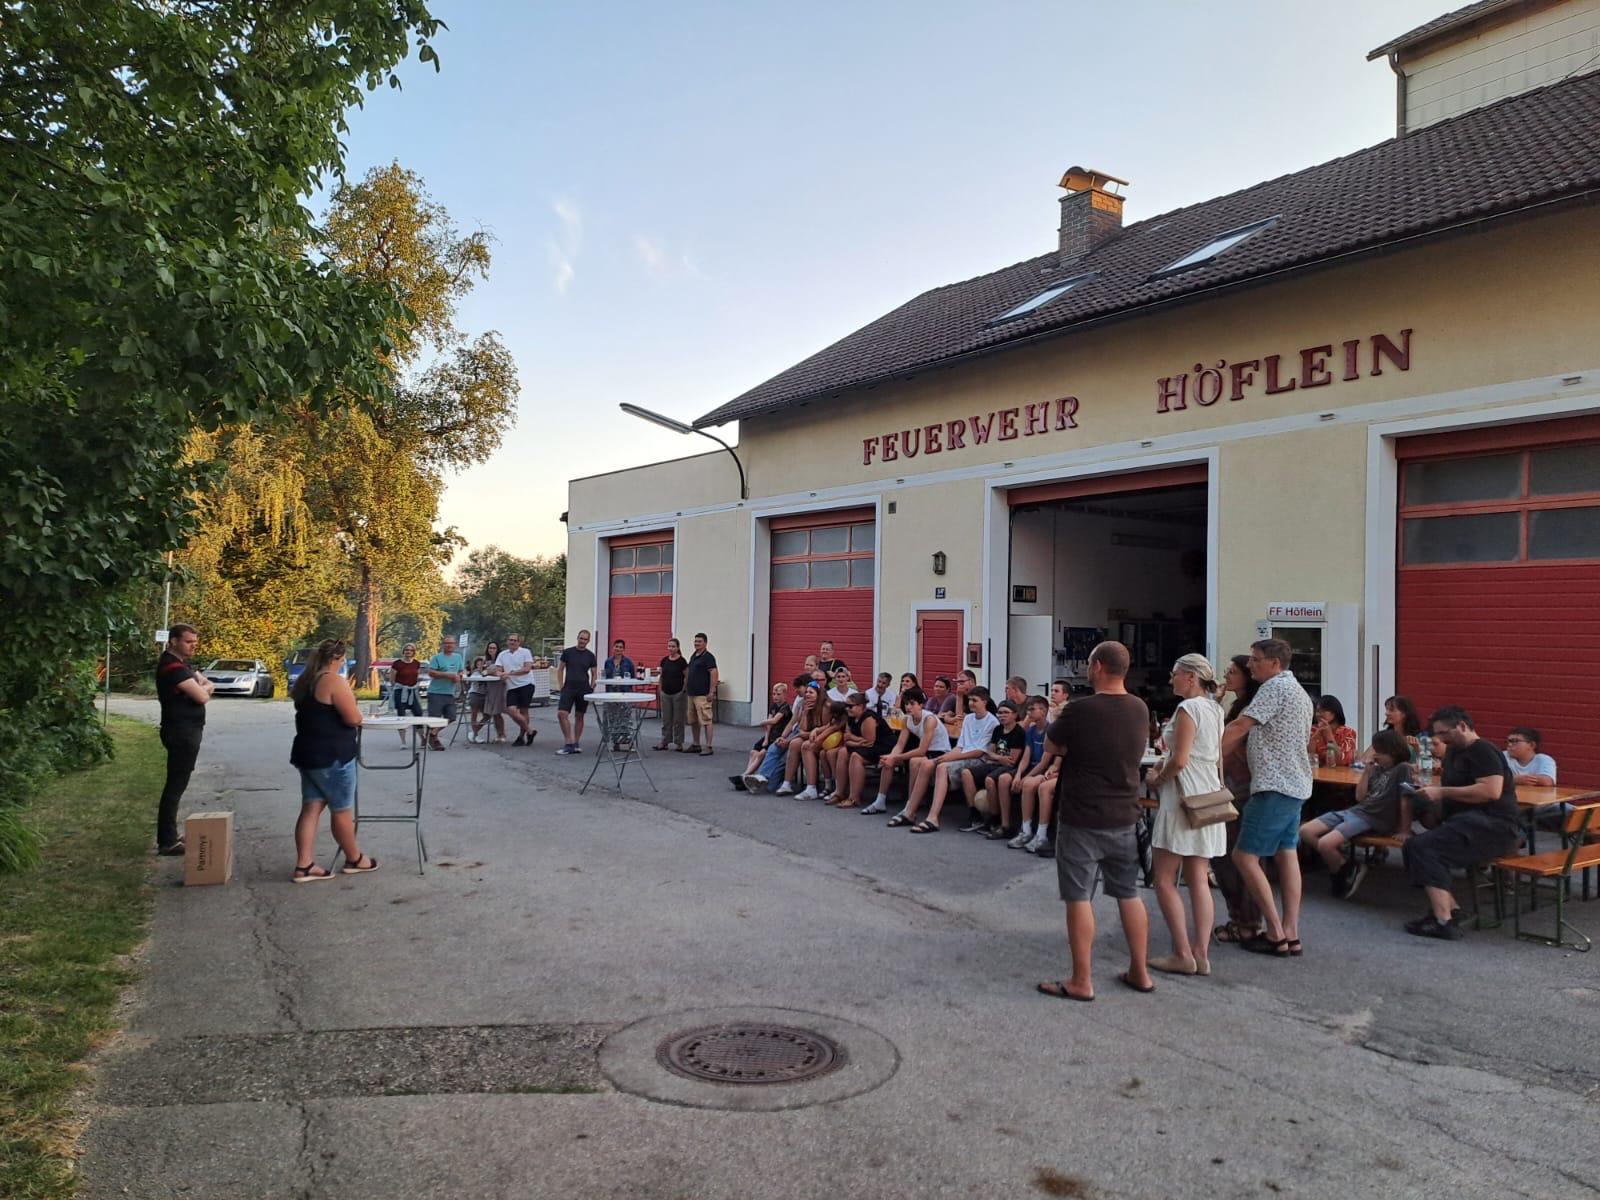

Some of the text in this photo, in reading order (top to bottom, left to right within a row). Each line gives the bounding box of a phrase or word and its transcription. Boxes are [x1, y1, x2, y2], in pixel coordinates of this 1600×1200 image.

[863, 328, 1413, 466] FEUERWEHR HÖFLEIN
[1269, 606, 1322, 617] FF Höflein
